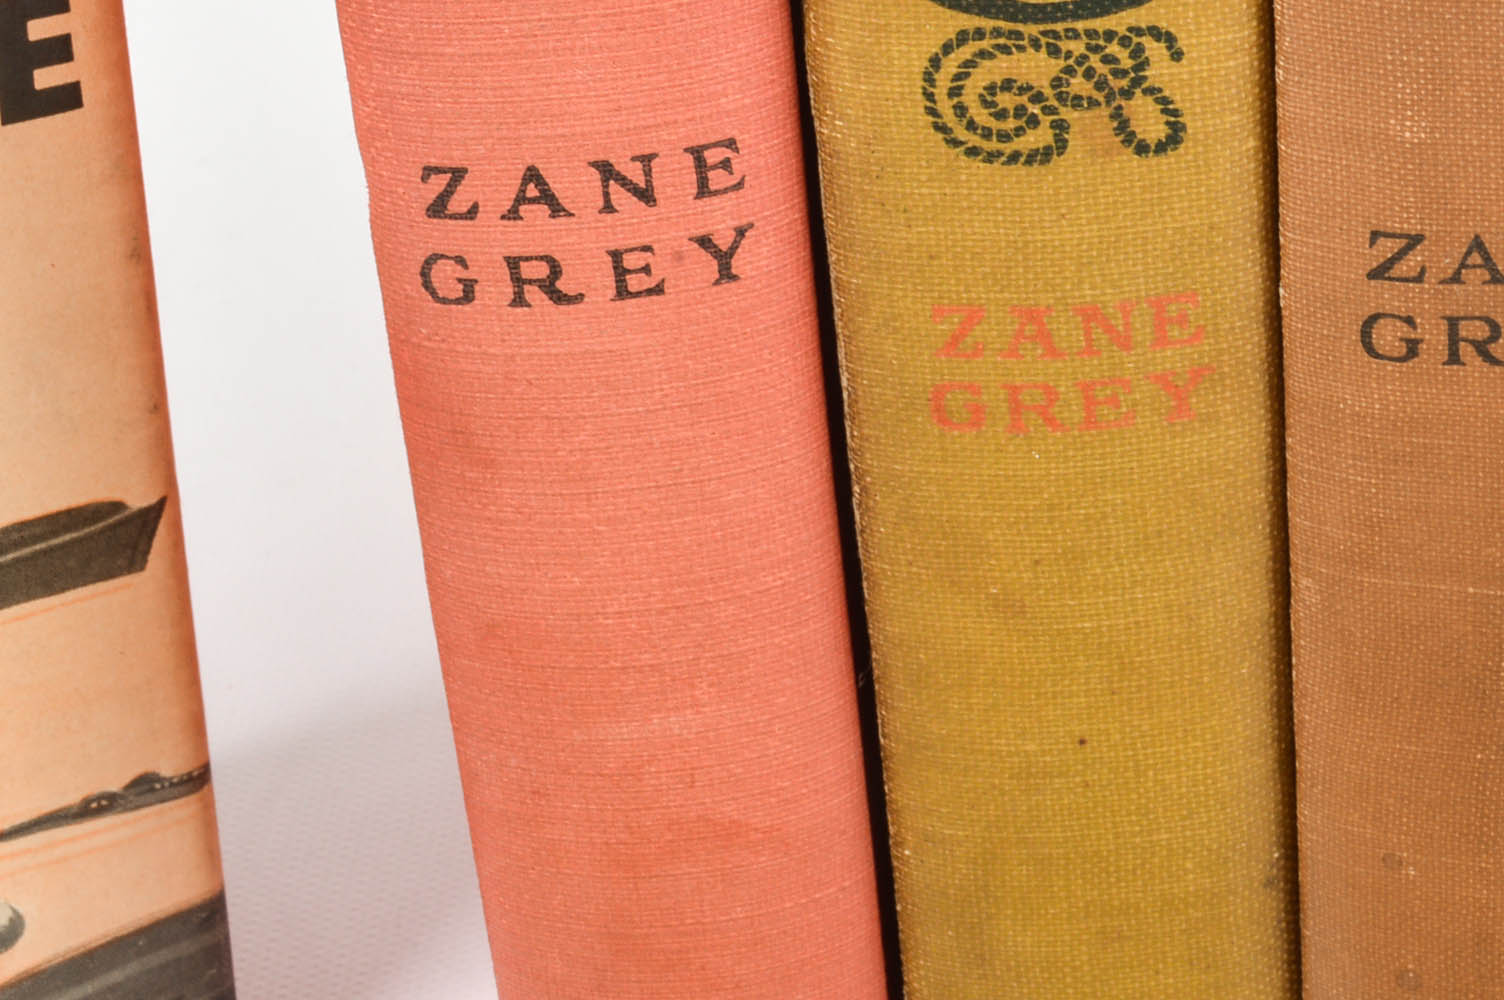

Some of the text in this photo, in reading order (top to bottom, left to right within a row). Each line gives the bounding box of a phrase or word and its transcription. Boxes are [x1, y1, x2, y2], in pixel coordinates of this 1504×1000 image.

[420, 137, 746, 221] ZANE
[419, 223, 754, 307] GREY
[930, 291, 1205, 361] ZANE
[928, 365, 1215, 435] GREY
